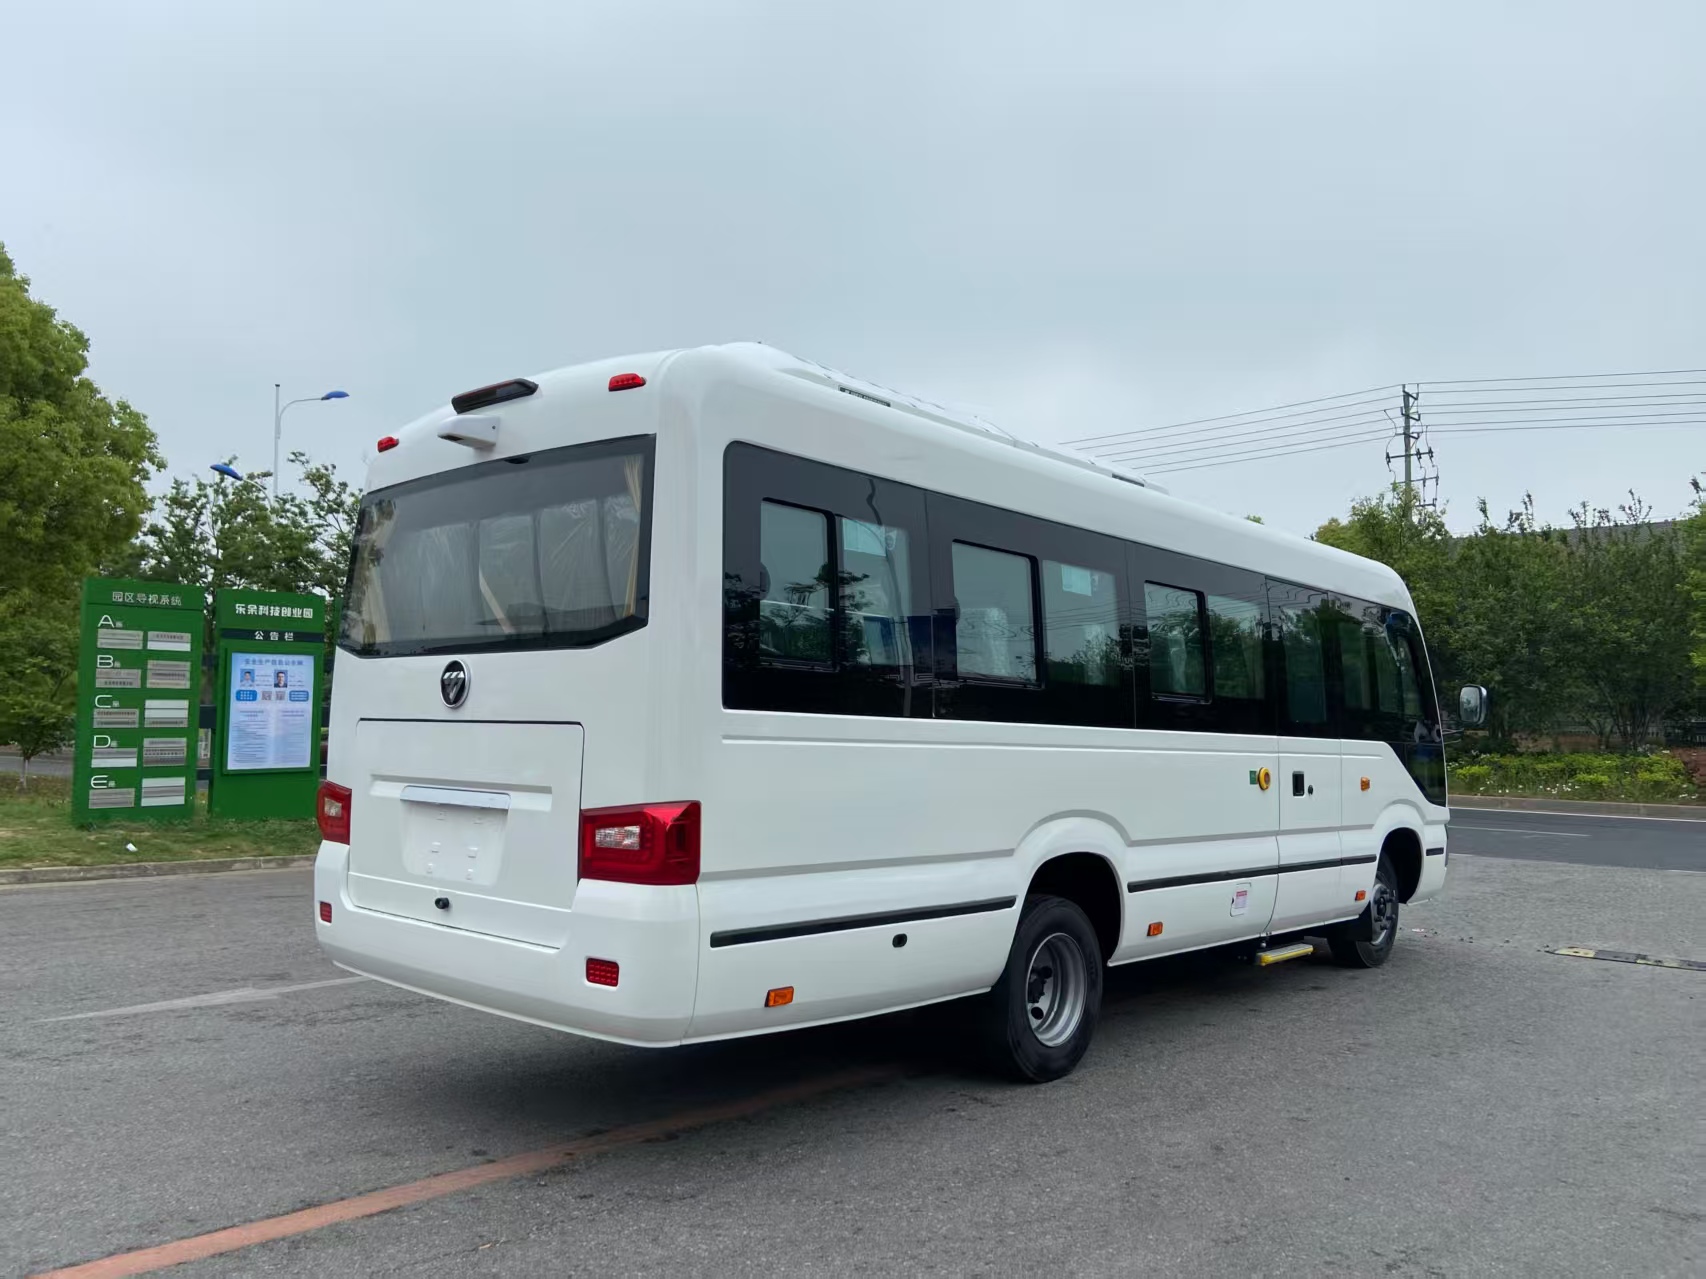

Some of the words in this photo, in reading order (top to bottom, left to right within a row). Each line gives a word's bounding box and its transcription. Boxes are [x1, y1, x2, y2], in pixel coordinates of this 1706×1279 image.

[112, 591, 182, 606] 园区导视系统
